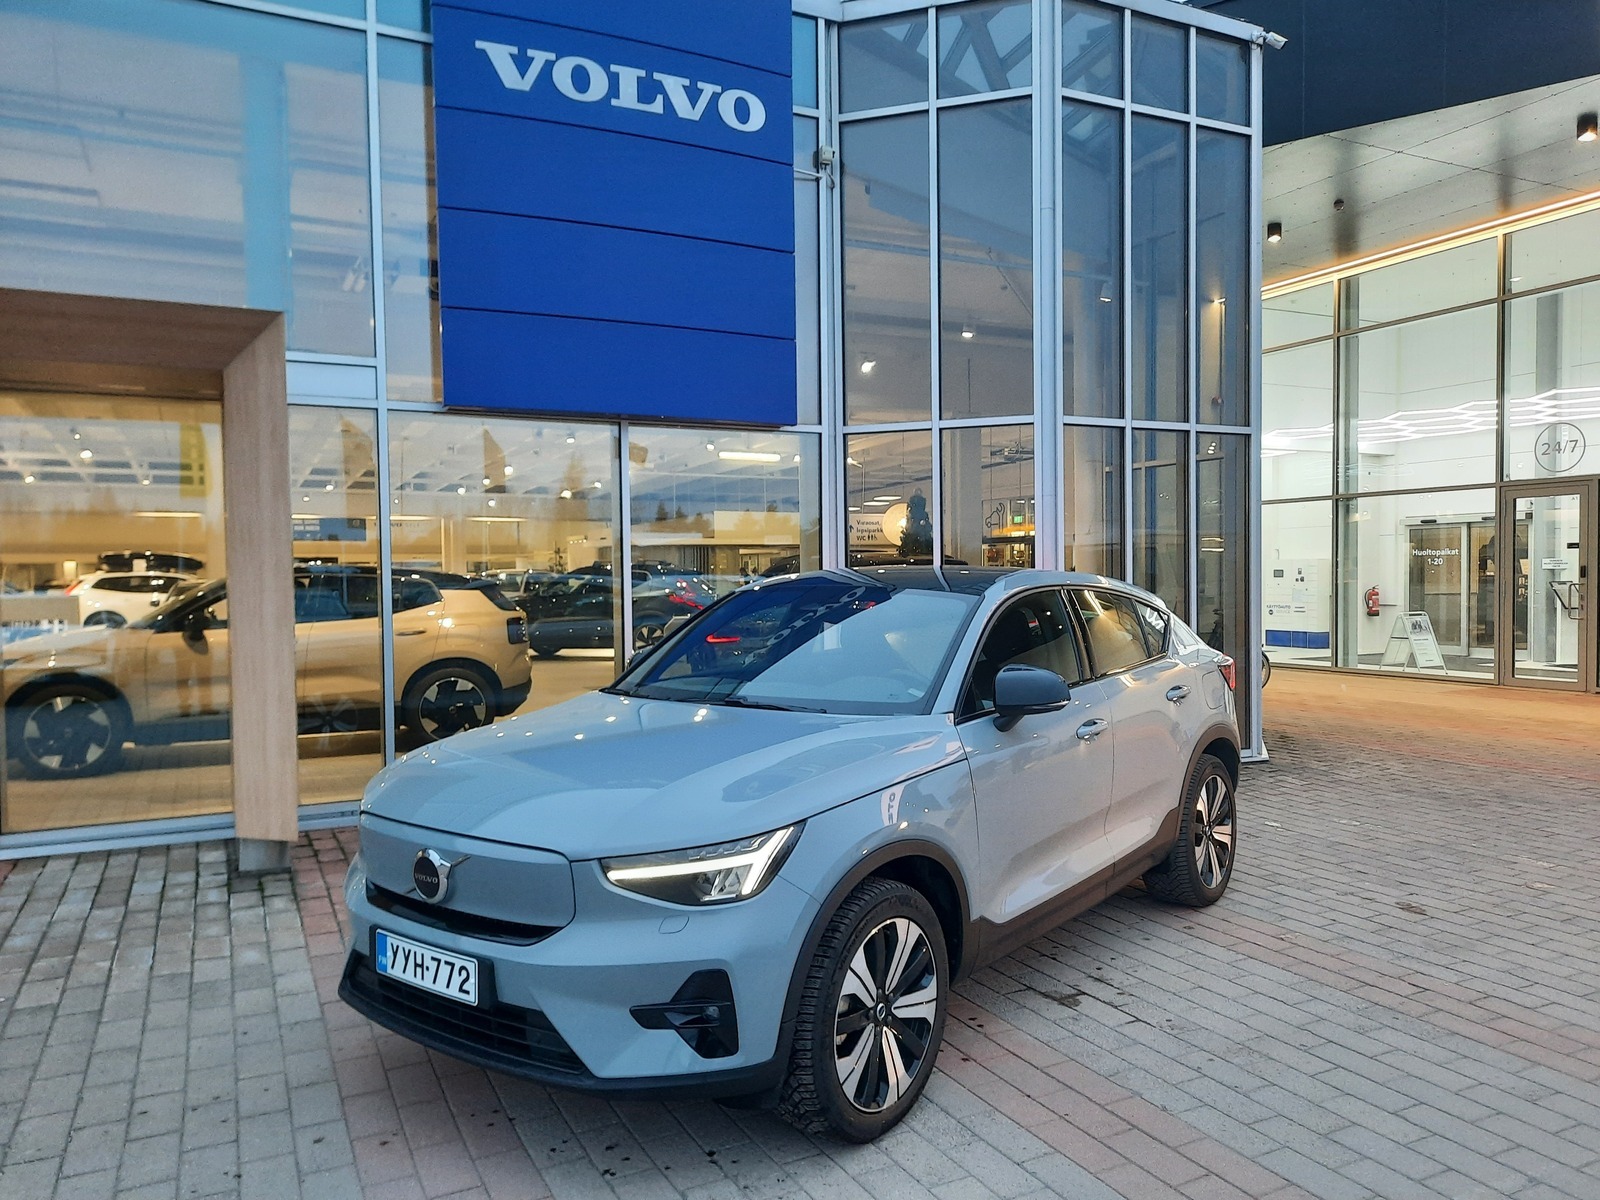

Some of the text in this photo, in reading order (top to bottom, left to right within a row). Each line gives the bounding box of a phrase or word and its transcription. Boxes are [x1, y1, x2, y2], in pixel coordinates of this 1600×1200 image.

[474, 40, 767, 132] VOLVO
[1541, 439, 1579, 456] 24/7
[1412, 548, 1459, 557] Huoltopaikat
[415, 873, 438, 884] VOLVO
[390, 942, 471, 996] YYH-772
